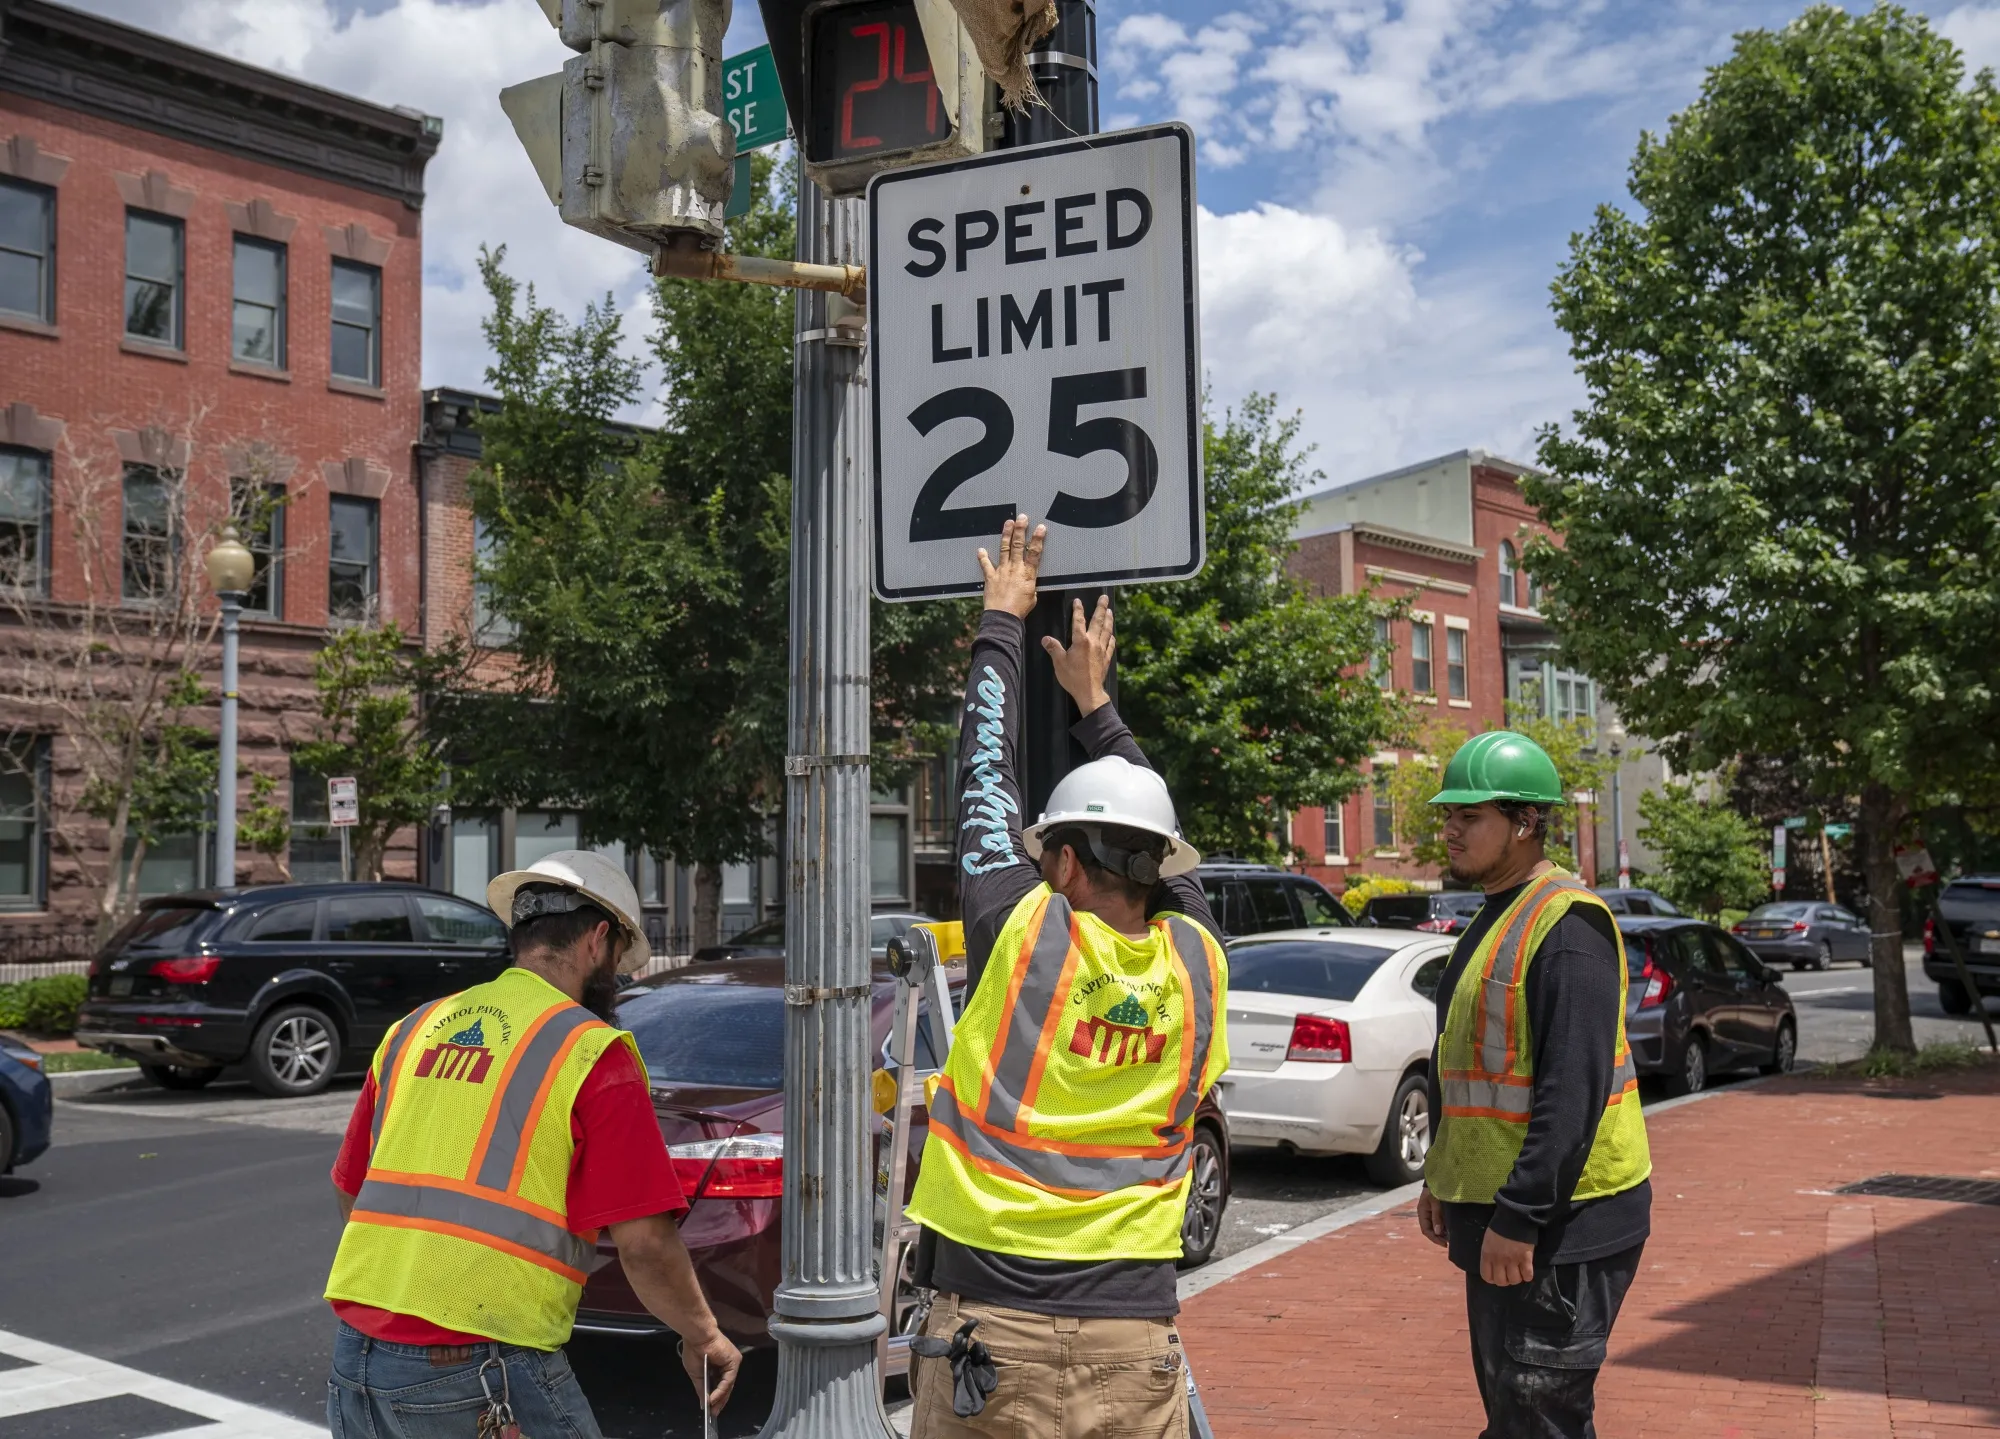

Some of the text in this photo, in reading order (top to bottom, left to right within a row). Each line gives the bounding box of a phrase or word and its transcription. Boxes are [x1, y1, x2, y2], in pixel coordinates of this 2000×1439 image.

[726, 61, 757, 100] ST
[727, 101, 757, 139] SE
[841, 21, 938, 149] 24
[904, 187, 1153, 278] SPEED
[931, 278, 1125, 363] LIMIT
[906, 366, 1159, 543] 25
[961, 665, 1020, 876] California
[476, 1005, 508, 1023] PAVING
[500, 1030, 511, 1046] DC
[1156, 1003, 1171, 1023] DC
